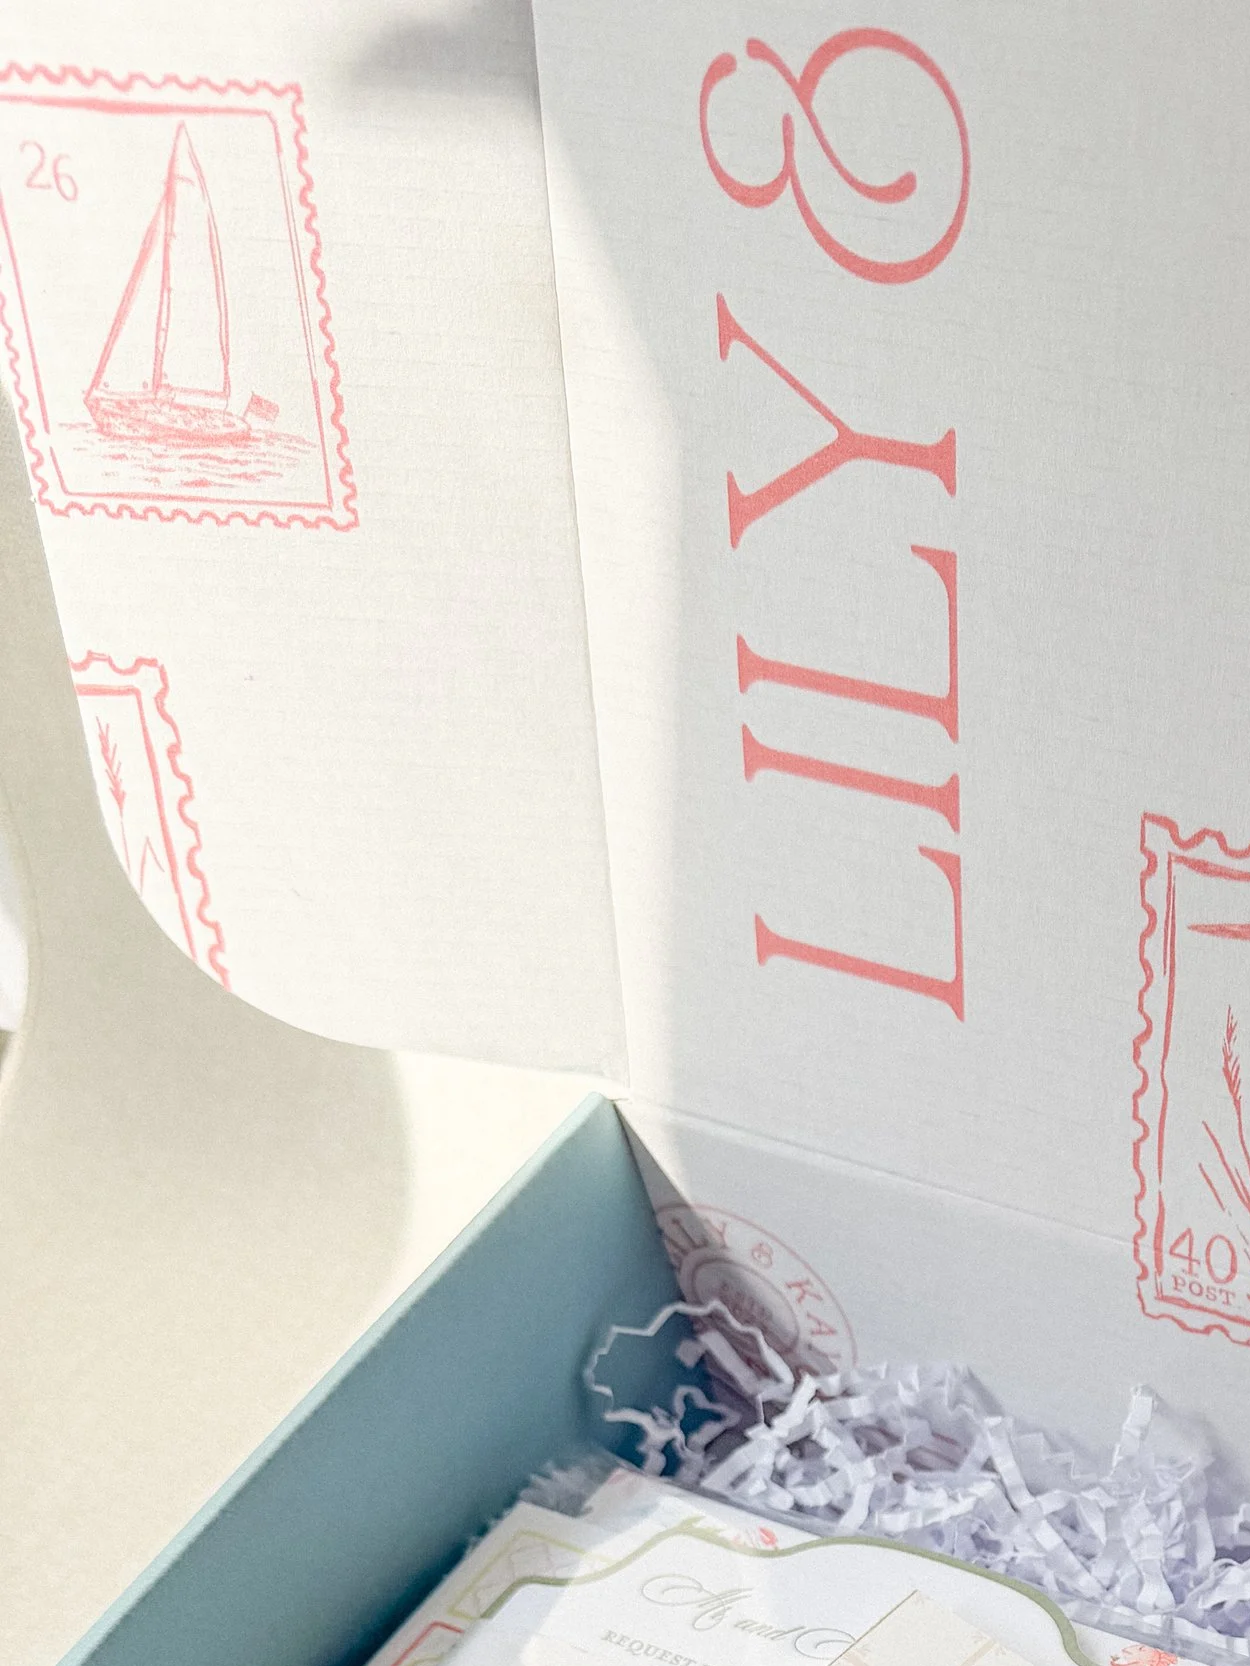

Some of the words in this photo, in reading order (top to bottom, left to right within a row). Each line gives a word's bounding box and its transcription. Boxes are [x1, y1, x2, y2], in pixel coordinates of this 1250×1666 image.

[19, 140, 79, 202] 26
[699, 27, 971, 285] &
[715, 291, 966, 1023] LILY
[1167, 1227, 1238, 1284] 40
[1173, 1275, 1237, 1307] POST
